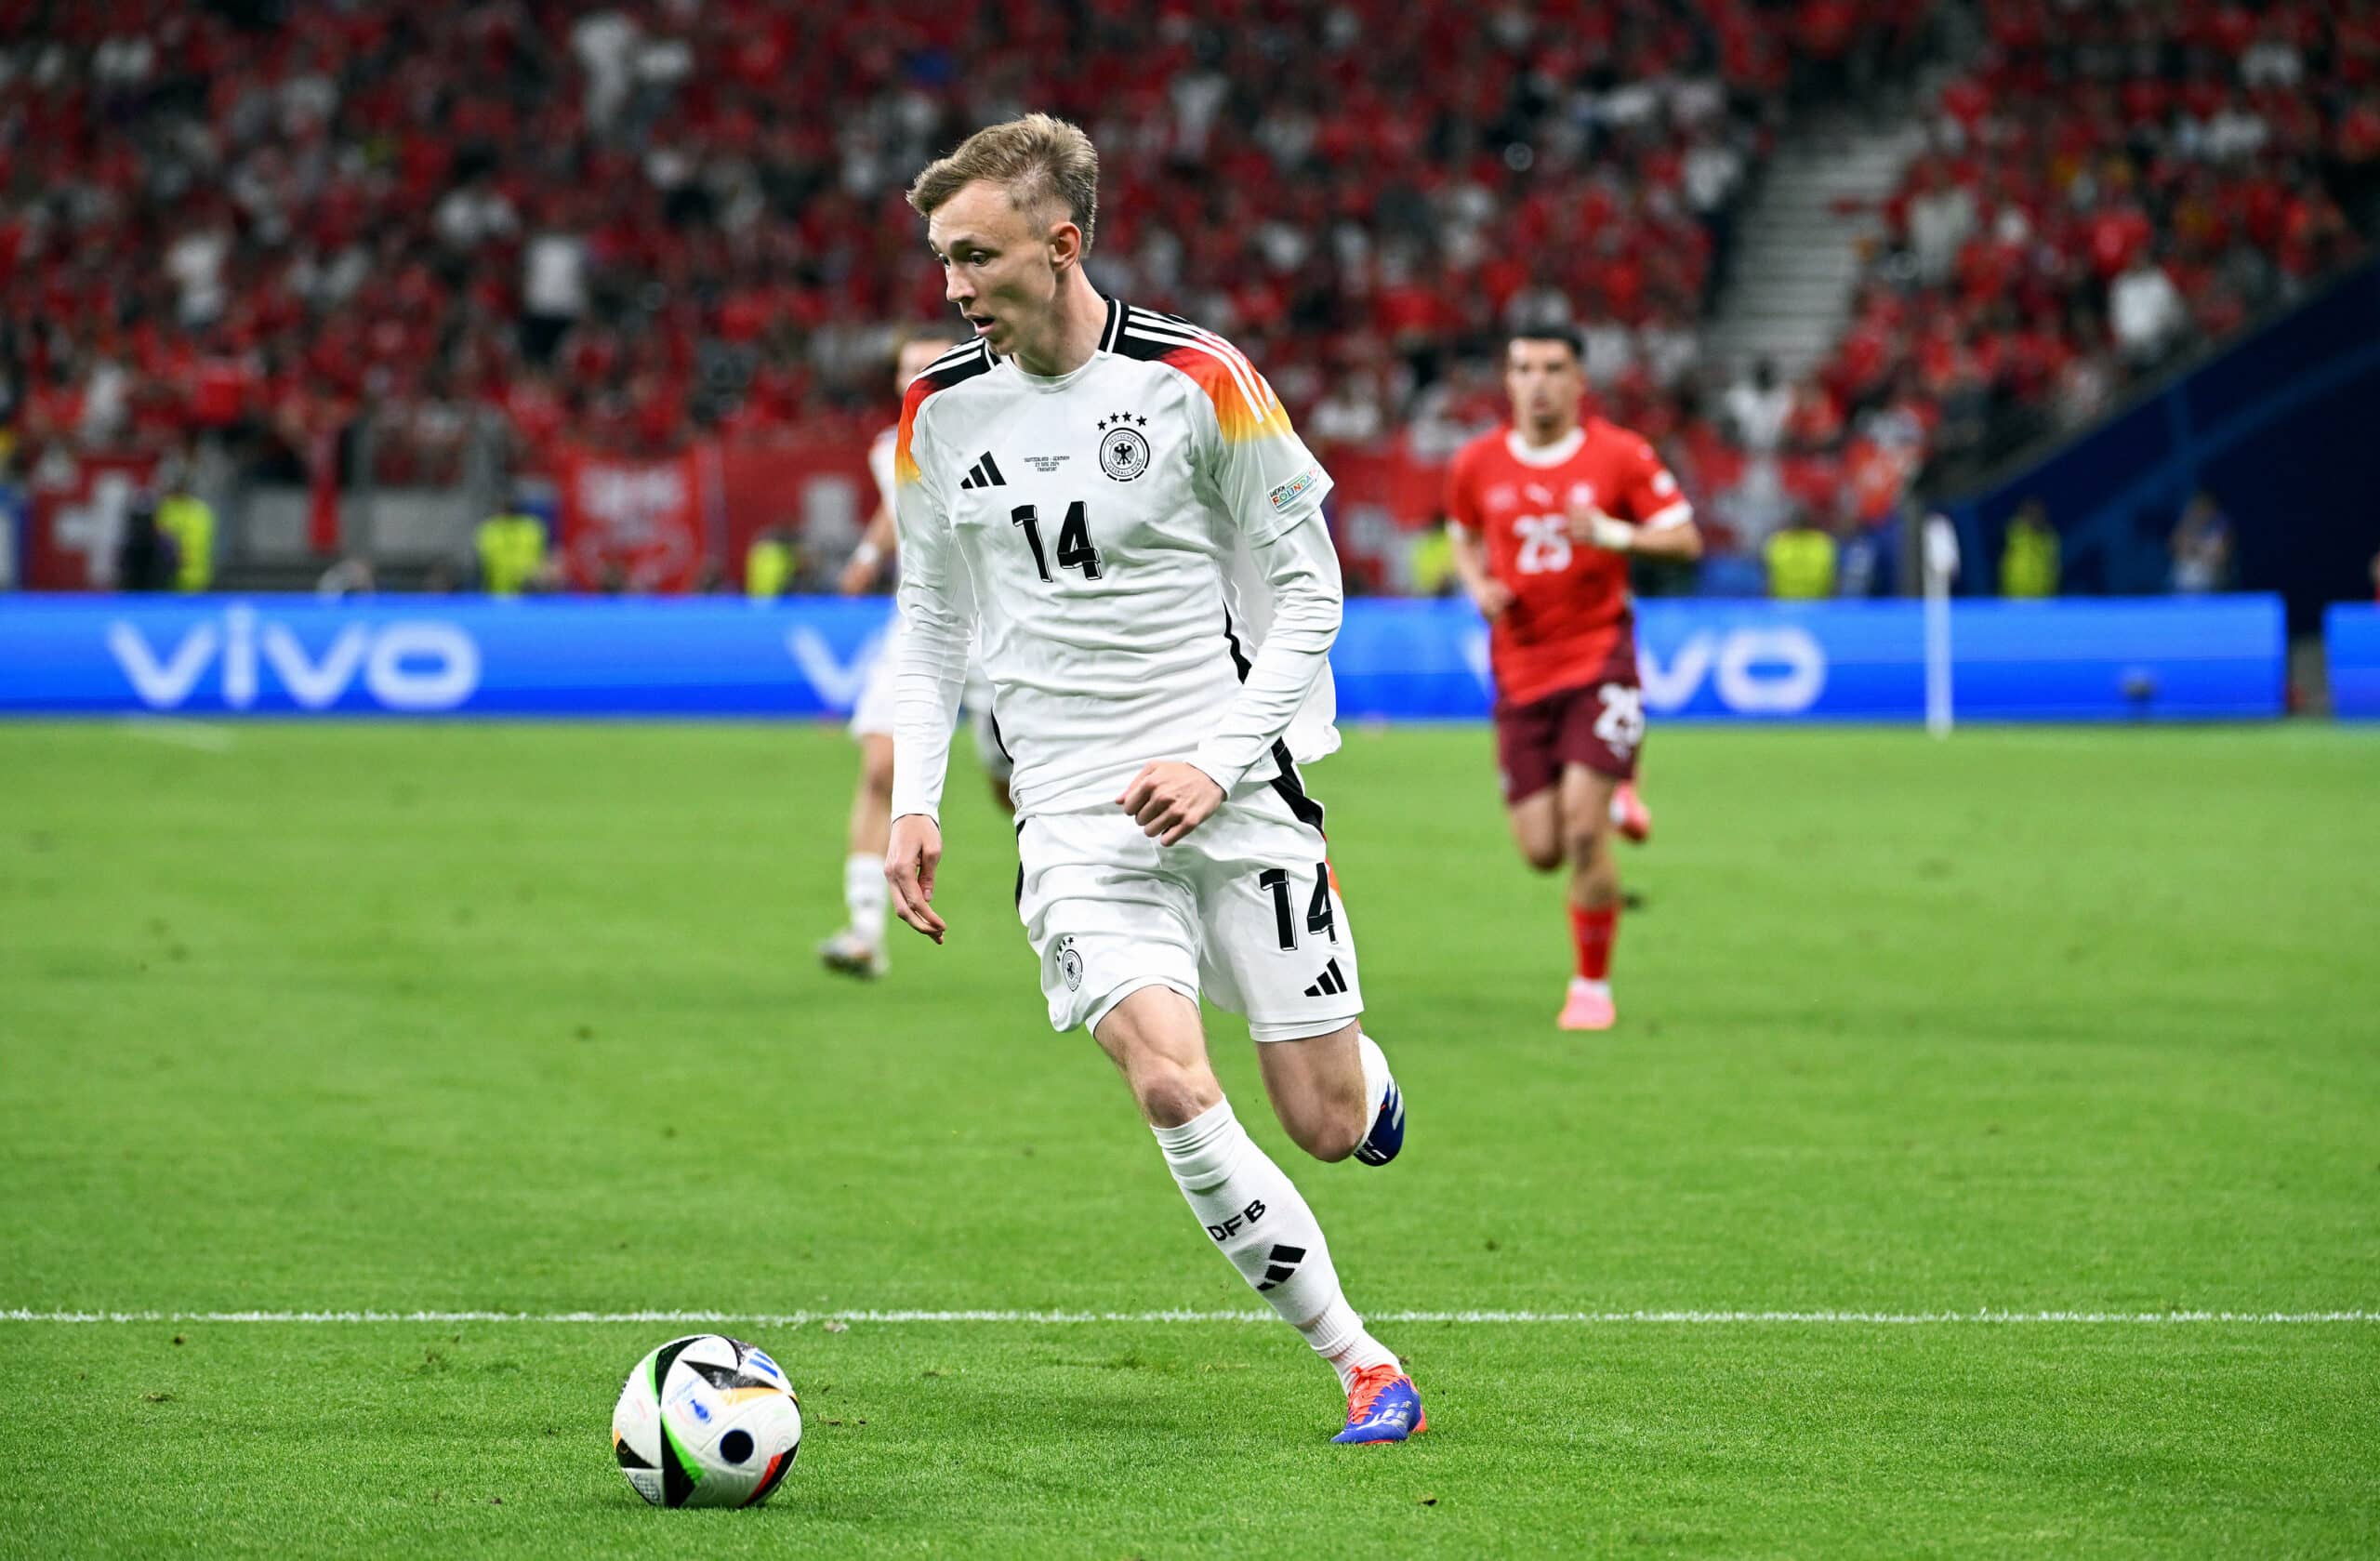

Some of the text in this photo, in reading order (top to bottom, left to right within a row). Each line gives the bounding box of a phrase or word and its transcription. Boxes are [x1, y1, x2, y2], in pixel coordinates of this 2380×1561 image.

[1011, 500, 1103, 583] 14
[1513, 513, 1572, 575] 25
[108, 603, 482, 711] vivo
[1259, 862, 1340, 952] 14
[1207, 1199, 1266, 1242] DFB
